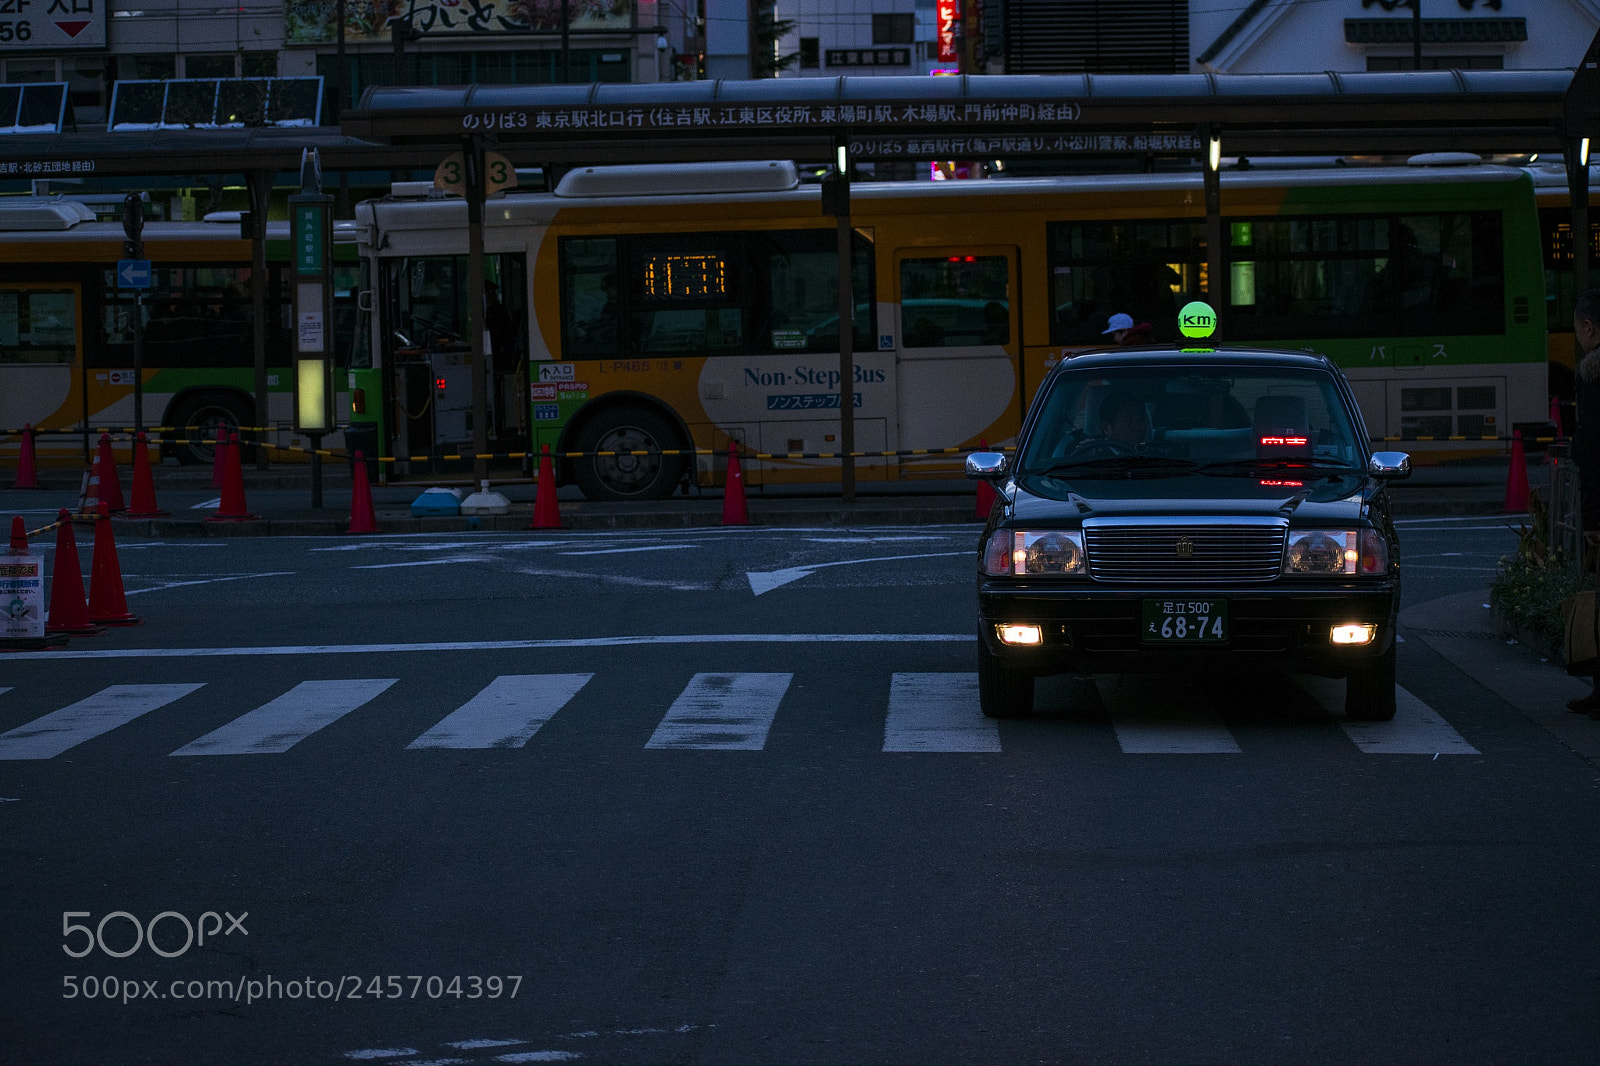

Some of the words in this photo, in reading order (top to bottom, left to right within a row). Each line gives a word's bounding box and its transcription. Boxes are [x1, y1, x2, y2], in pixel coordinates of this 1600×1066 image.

[46, 0, 93, 14] 入口
[462, 111, 527, 129] のりば3
[443, 161, 461, 184] 3
[490, 161, 508, 184] 3
[552, 365, 572, 375] 入口
[1163, 602, 1187, 614] 足立
[1188, 602, 1210, 614] 500
[1161, 616, 1223, 639] 68-74
